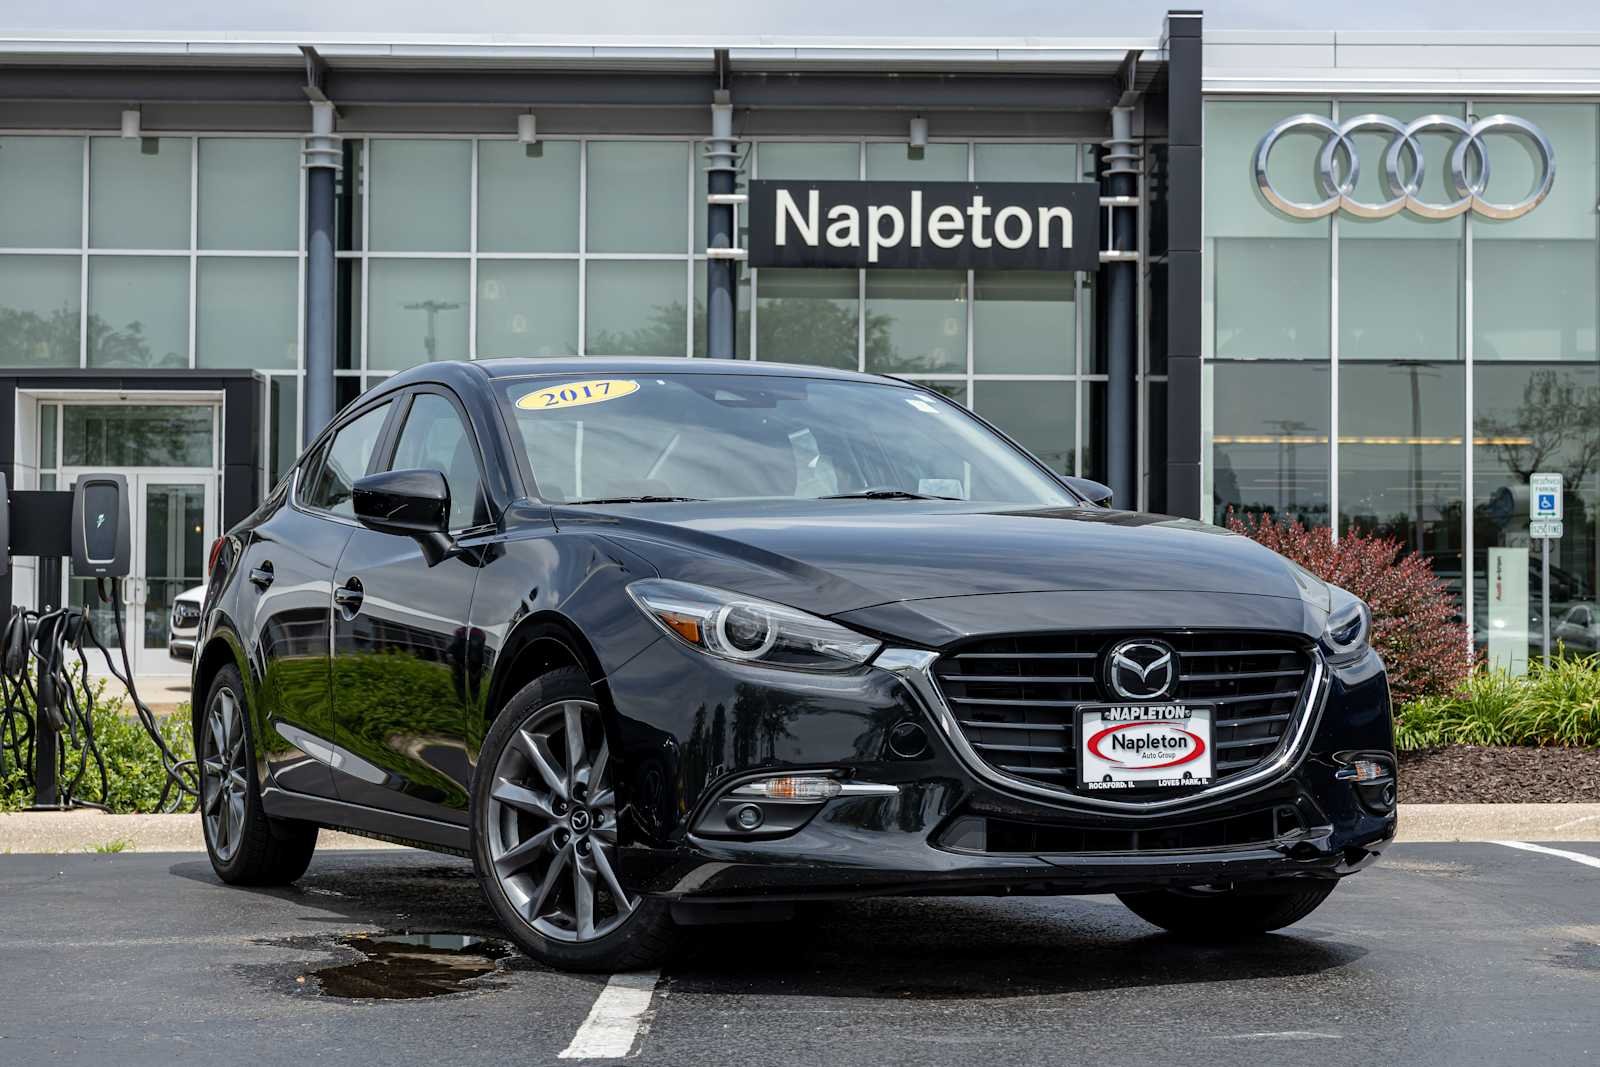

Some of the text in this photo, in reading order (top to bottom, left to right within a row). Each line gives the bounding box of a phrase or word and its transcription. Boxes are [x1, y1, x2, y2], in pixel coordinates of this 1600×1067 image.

[775, 189, 1073, 263] Napleton
[540, 382, 610, 407] 2017
[1110, 706, 1186, 720] NAPLETON
[1112, 733, 1187, 753] Napleton
[1141, 751, 1176, 760] Auto Group
[1158, 779, 1180, 787] LOVES
[1201, 777, 1209, 785] IL
